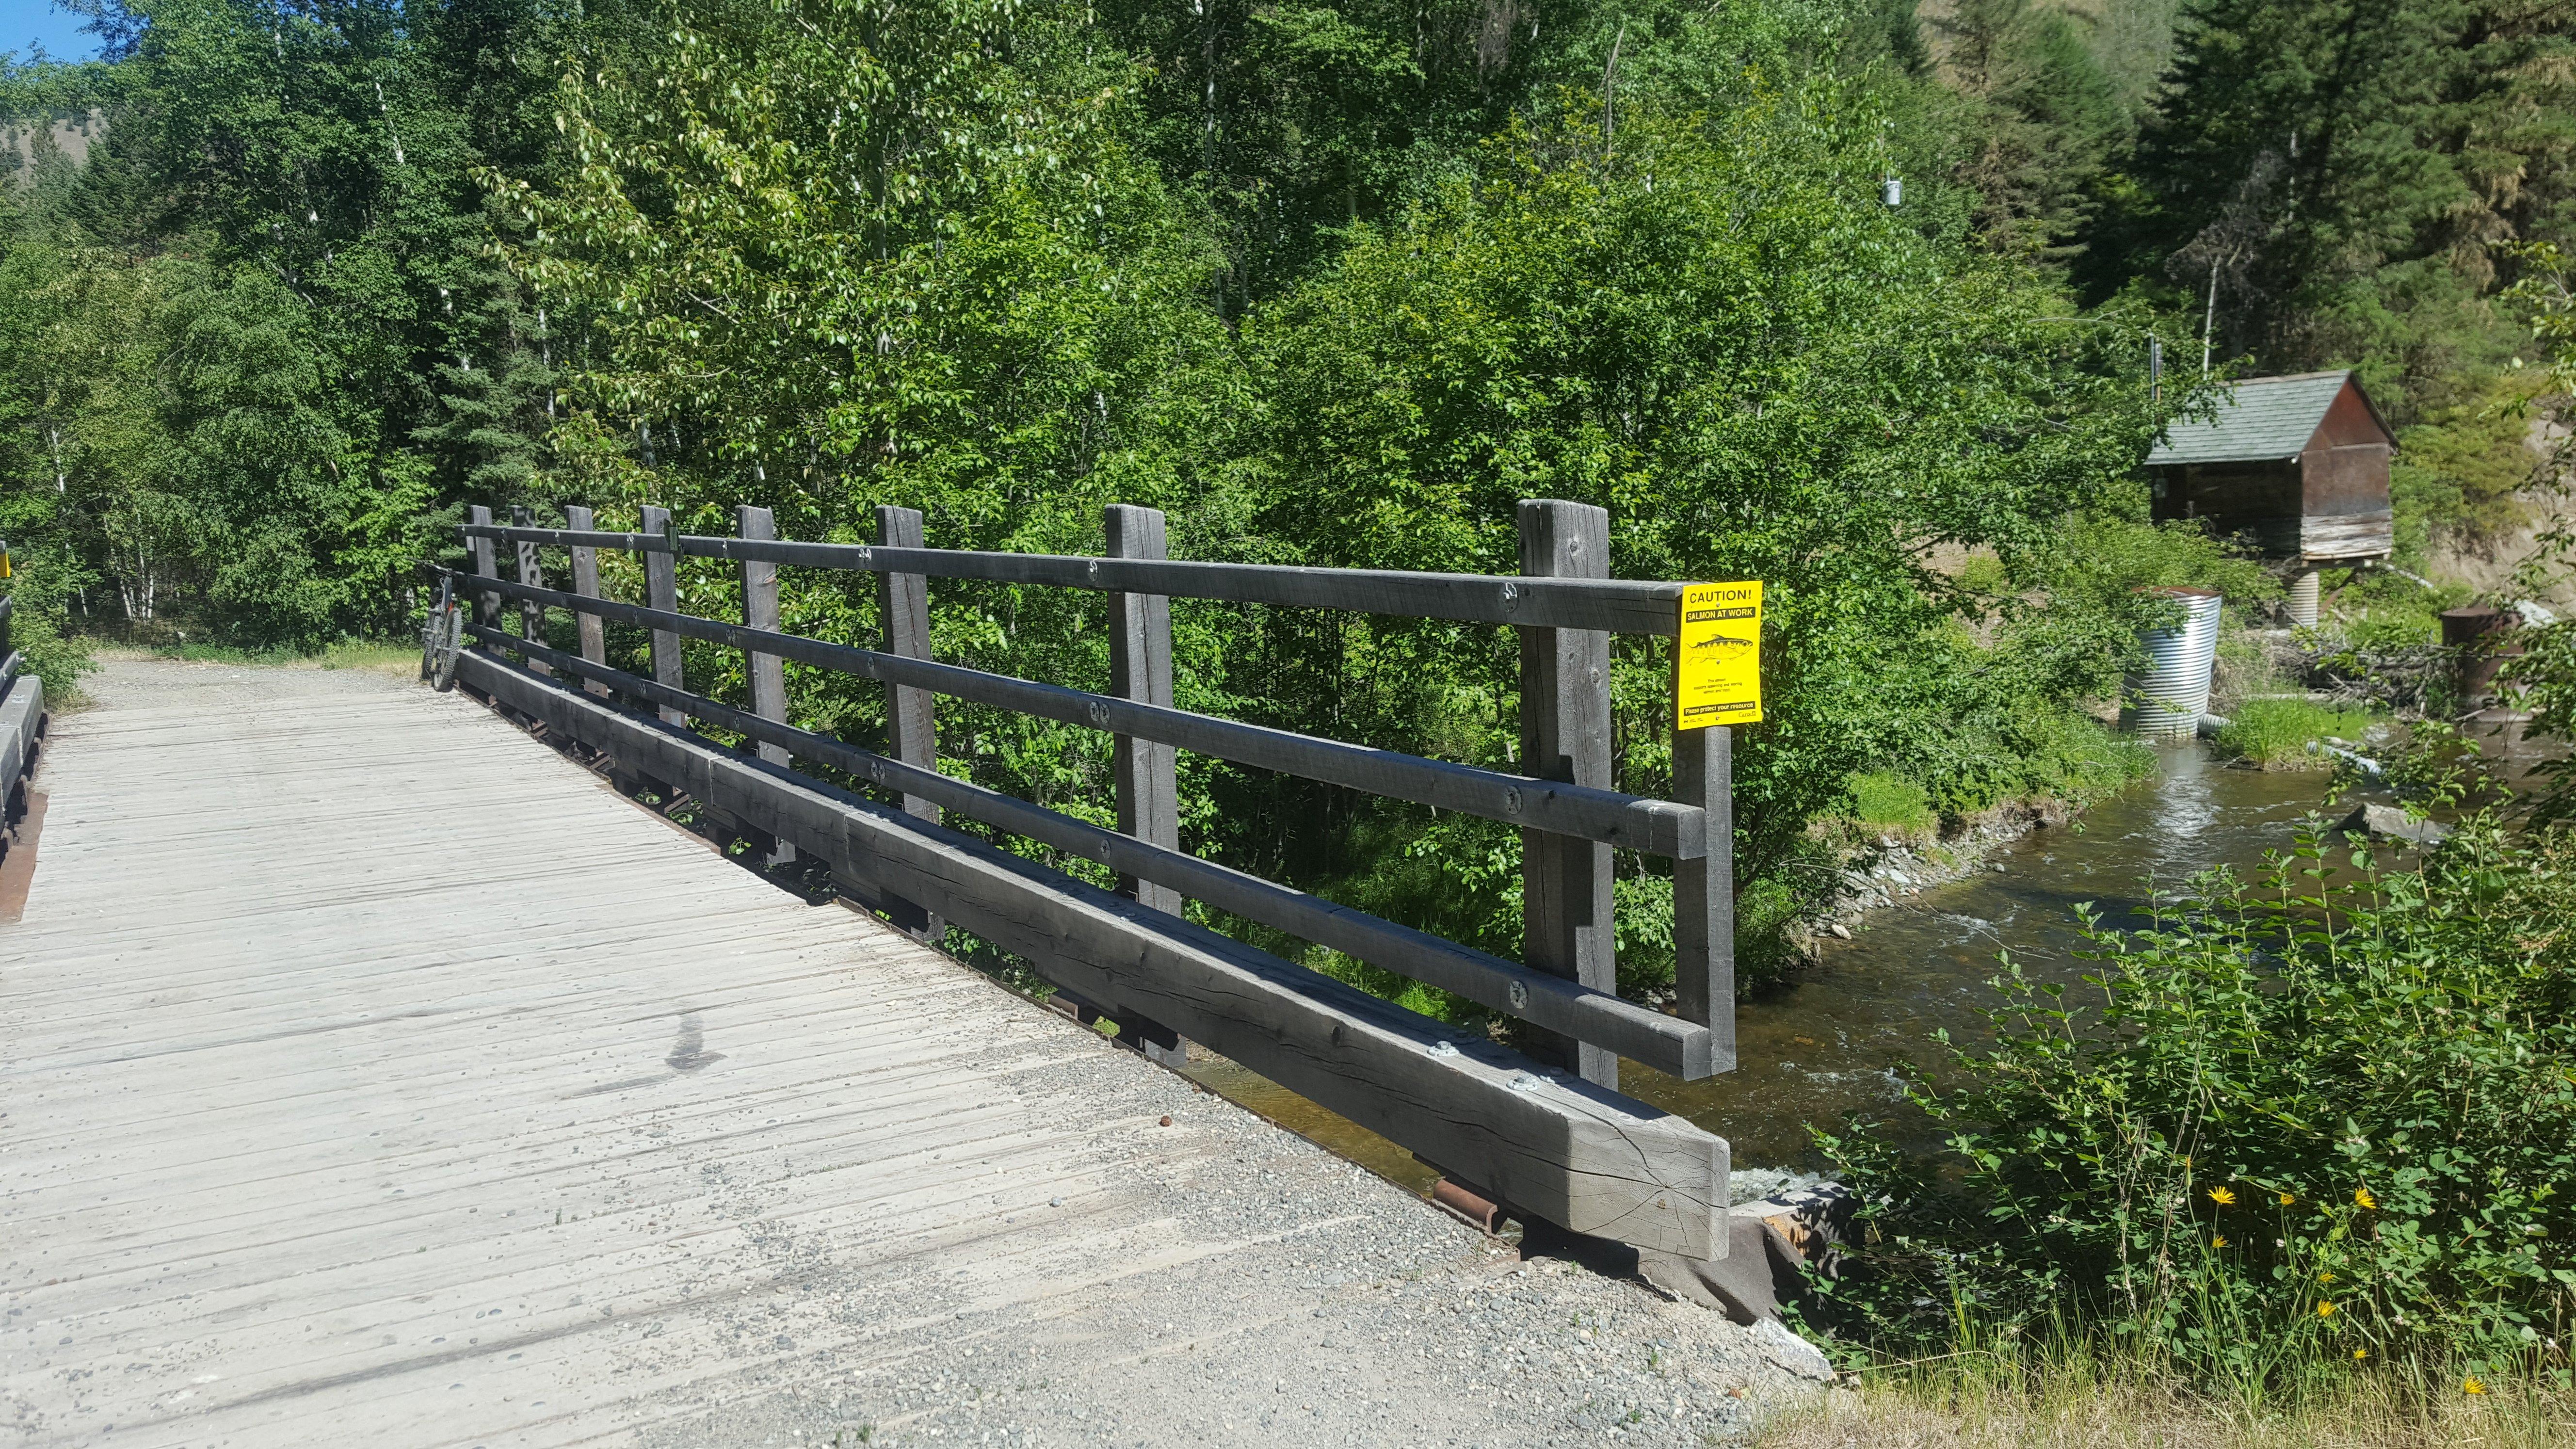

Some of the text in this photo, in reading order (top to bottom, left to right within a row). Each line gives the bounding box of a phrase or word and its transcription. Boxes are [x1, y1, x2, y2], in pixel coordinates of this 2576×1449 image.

[1690, 589, 1751, 603] CAUTION!
[1688, 608, 1753, 620] SALMON AT WORK
